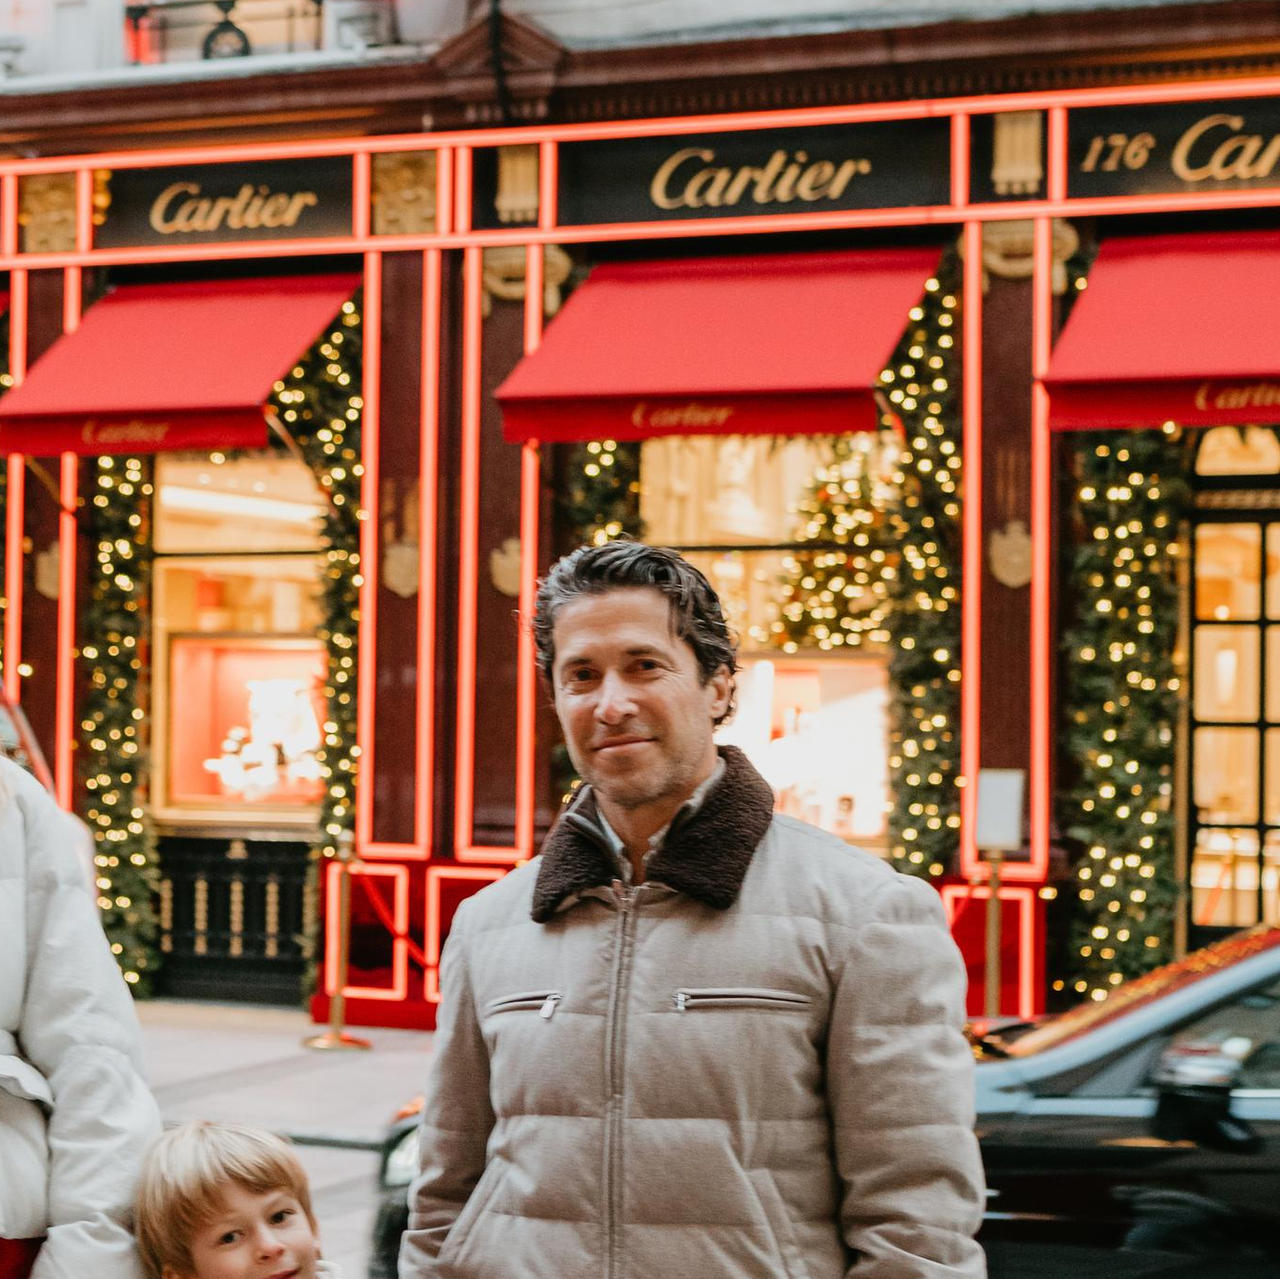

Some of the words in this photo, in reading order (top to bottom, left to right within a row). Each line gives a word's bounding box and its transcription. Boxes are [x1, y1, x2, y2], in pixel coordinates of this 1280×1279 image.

[650, 147, 872, 209] Cartier
[1080, 132, 1156, 172] 176
[149, 181, 318, 235] Cartier
